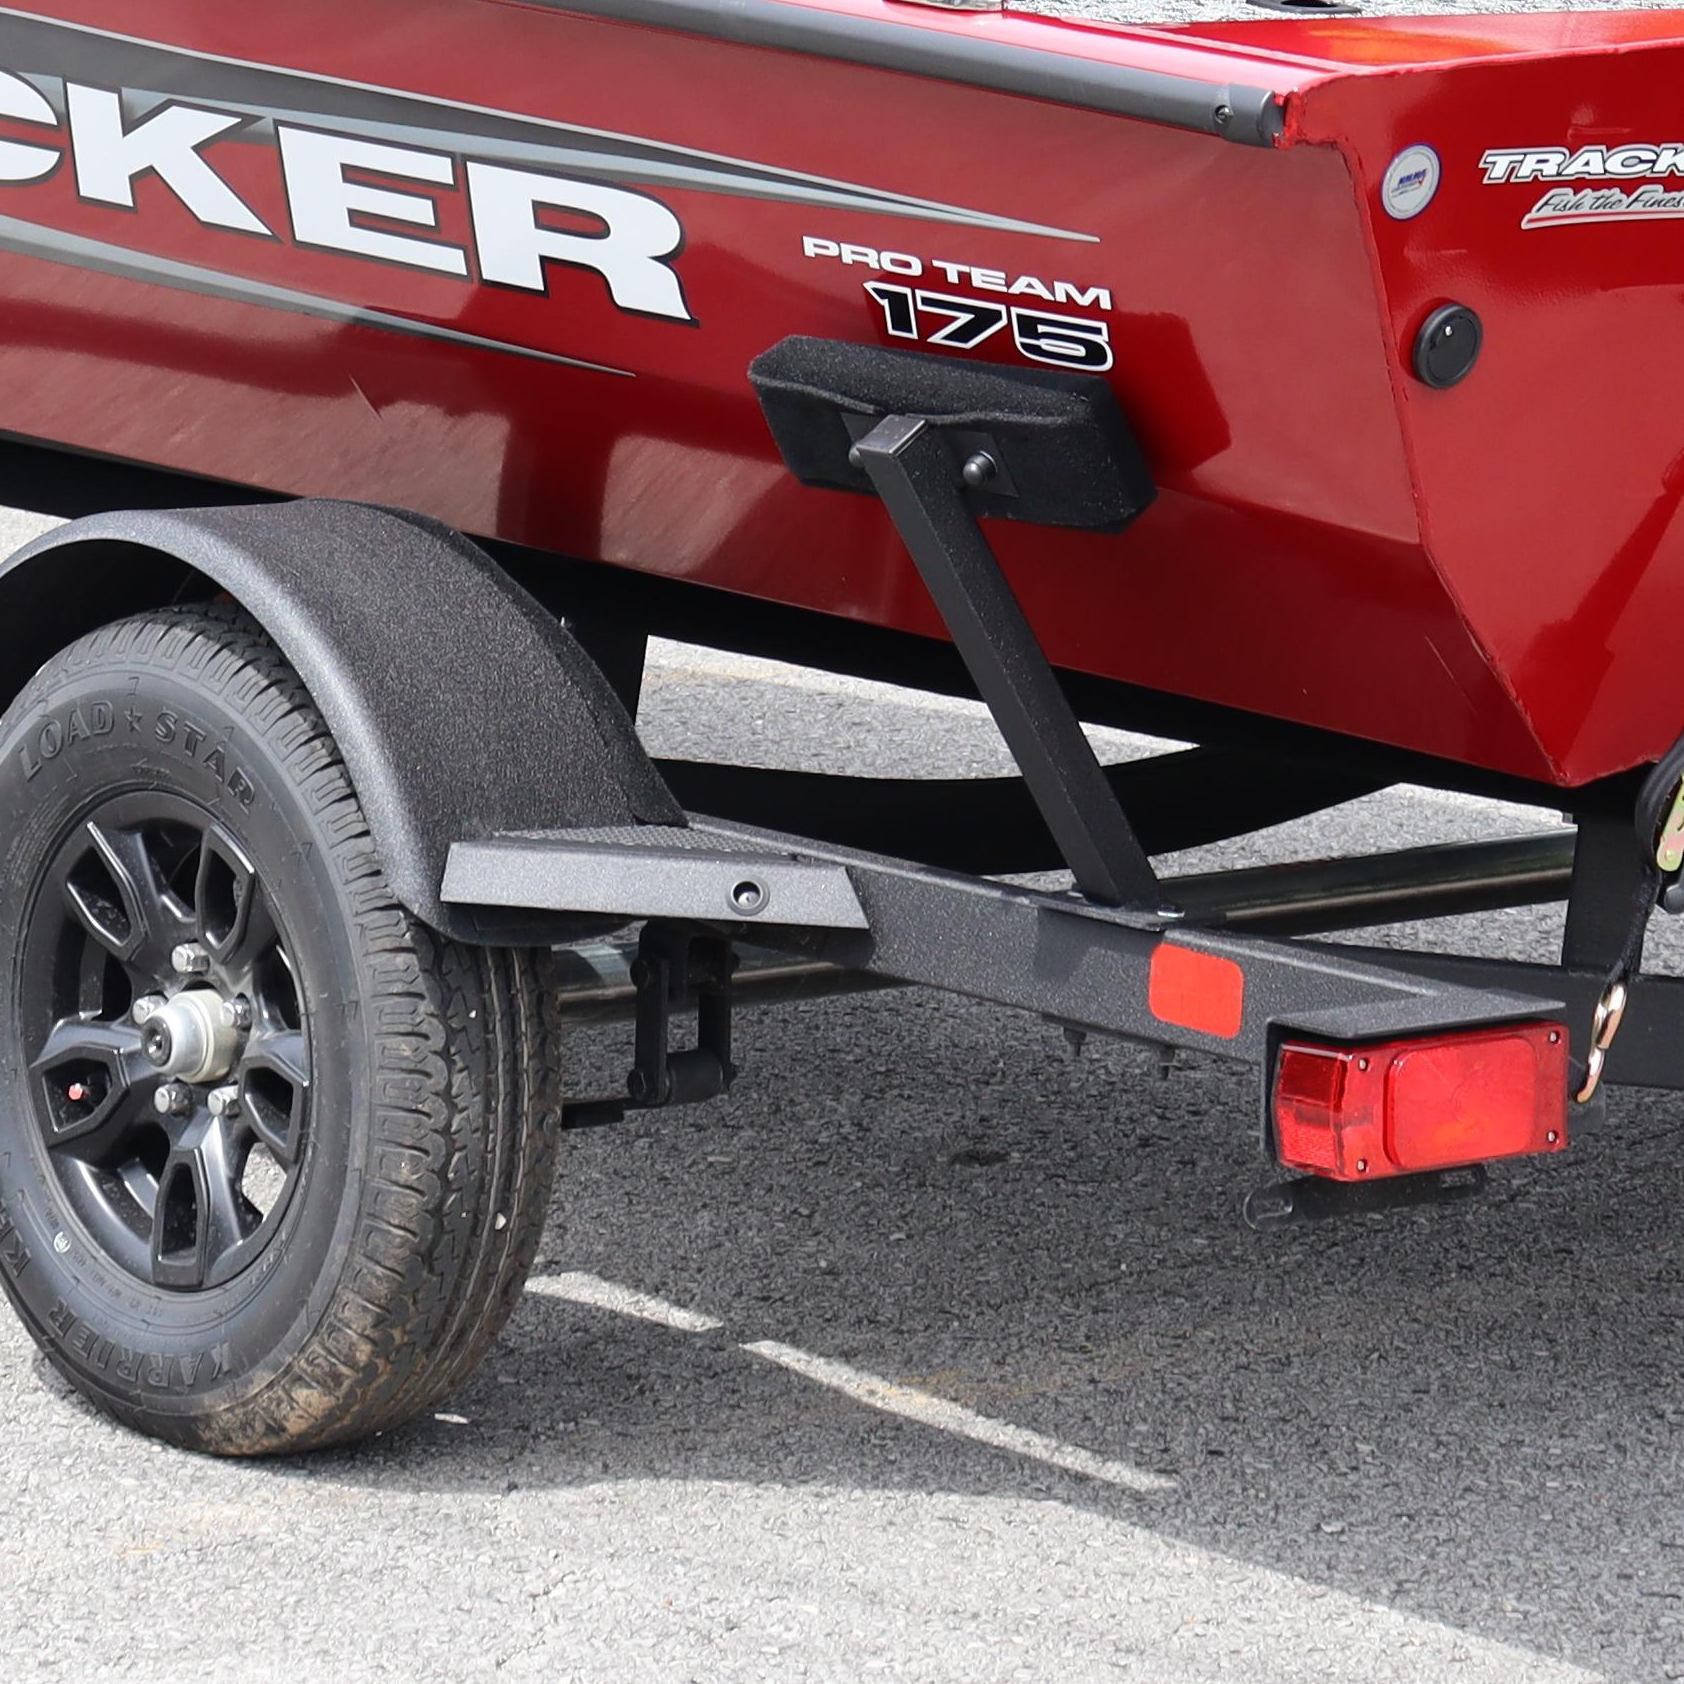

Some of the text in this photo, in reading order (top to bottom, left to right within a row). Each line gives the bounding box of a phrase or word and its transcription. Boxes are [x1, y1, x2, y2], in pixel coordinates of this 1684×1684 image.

[1536, 191, 1586, 213] Fish
[1588, 190, 1625, 211] the
[802, 235, 1113, 311] PRO TEAM
[862, 281, 1116, 372] 175
[19, 698, 258, 815] LOAD STAR
